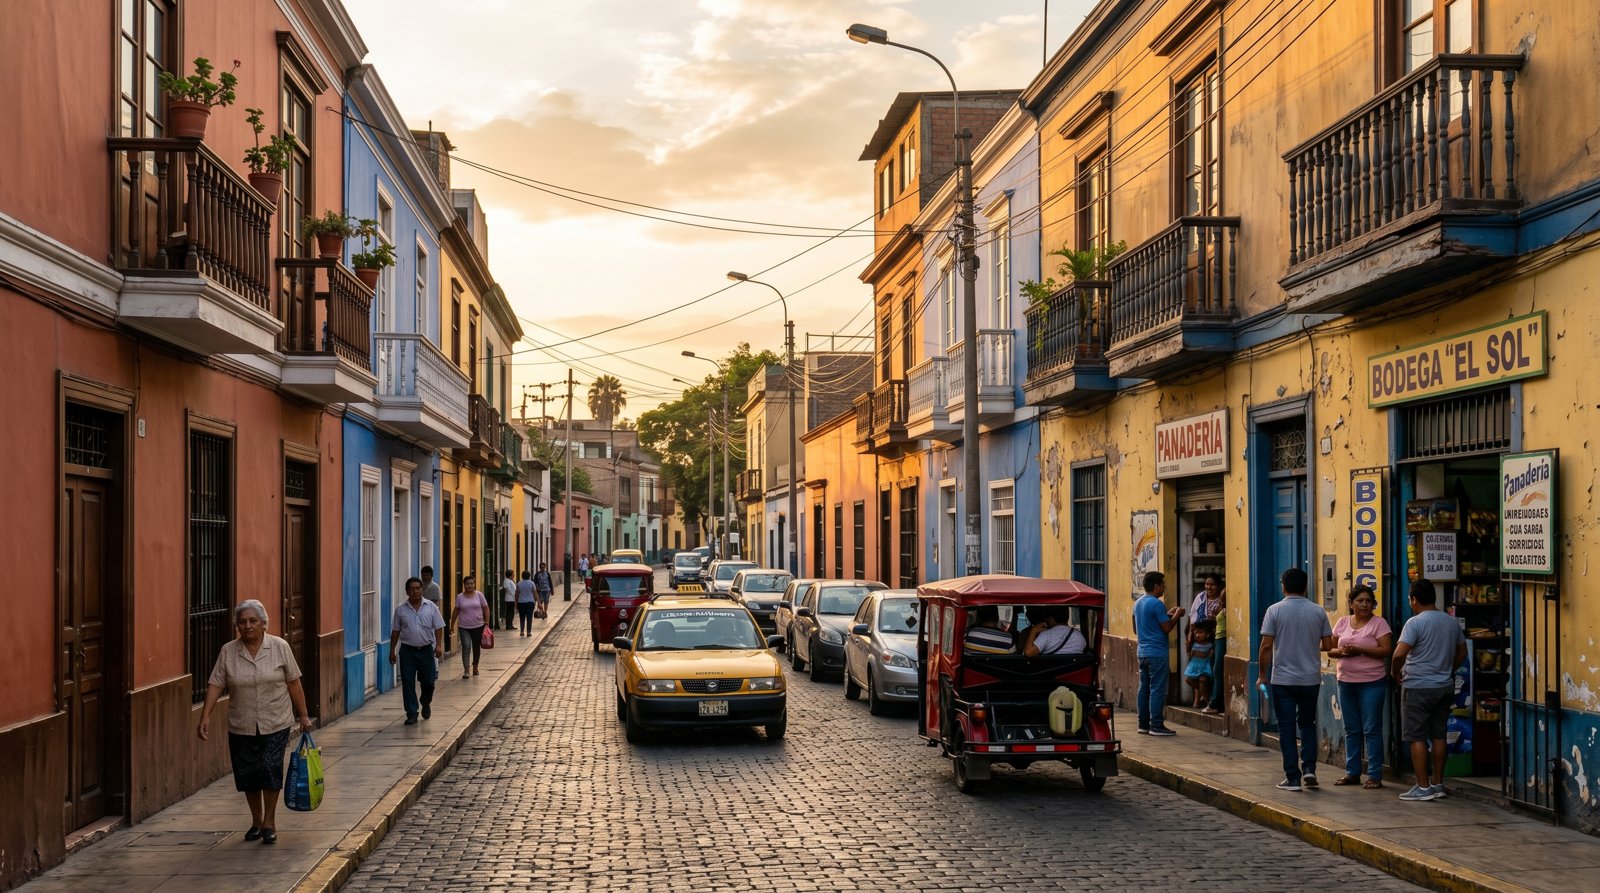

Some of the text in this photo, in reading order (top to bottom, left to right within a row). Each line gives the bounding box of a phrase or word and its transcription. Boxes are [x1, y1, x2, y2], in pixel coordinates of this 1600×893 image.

[1373, 350, 1443, 398] BODEGA
[1158, 414, 1223, 463] PANADERÍA
[1356, 481, 1377, 609] BODEG
